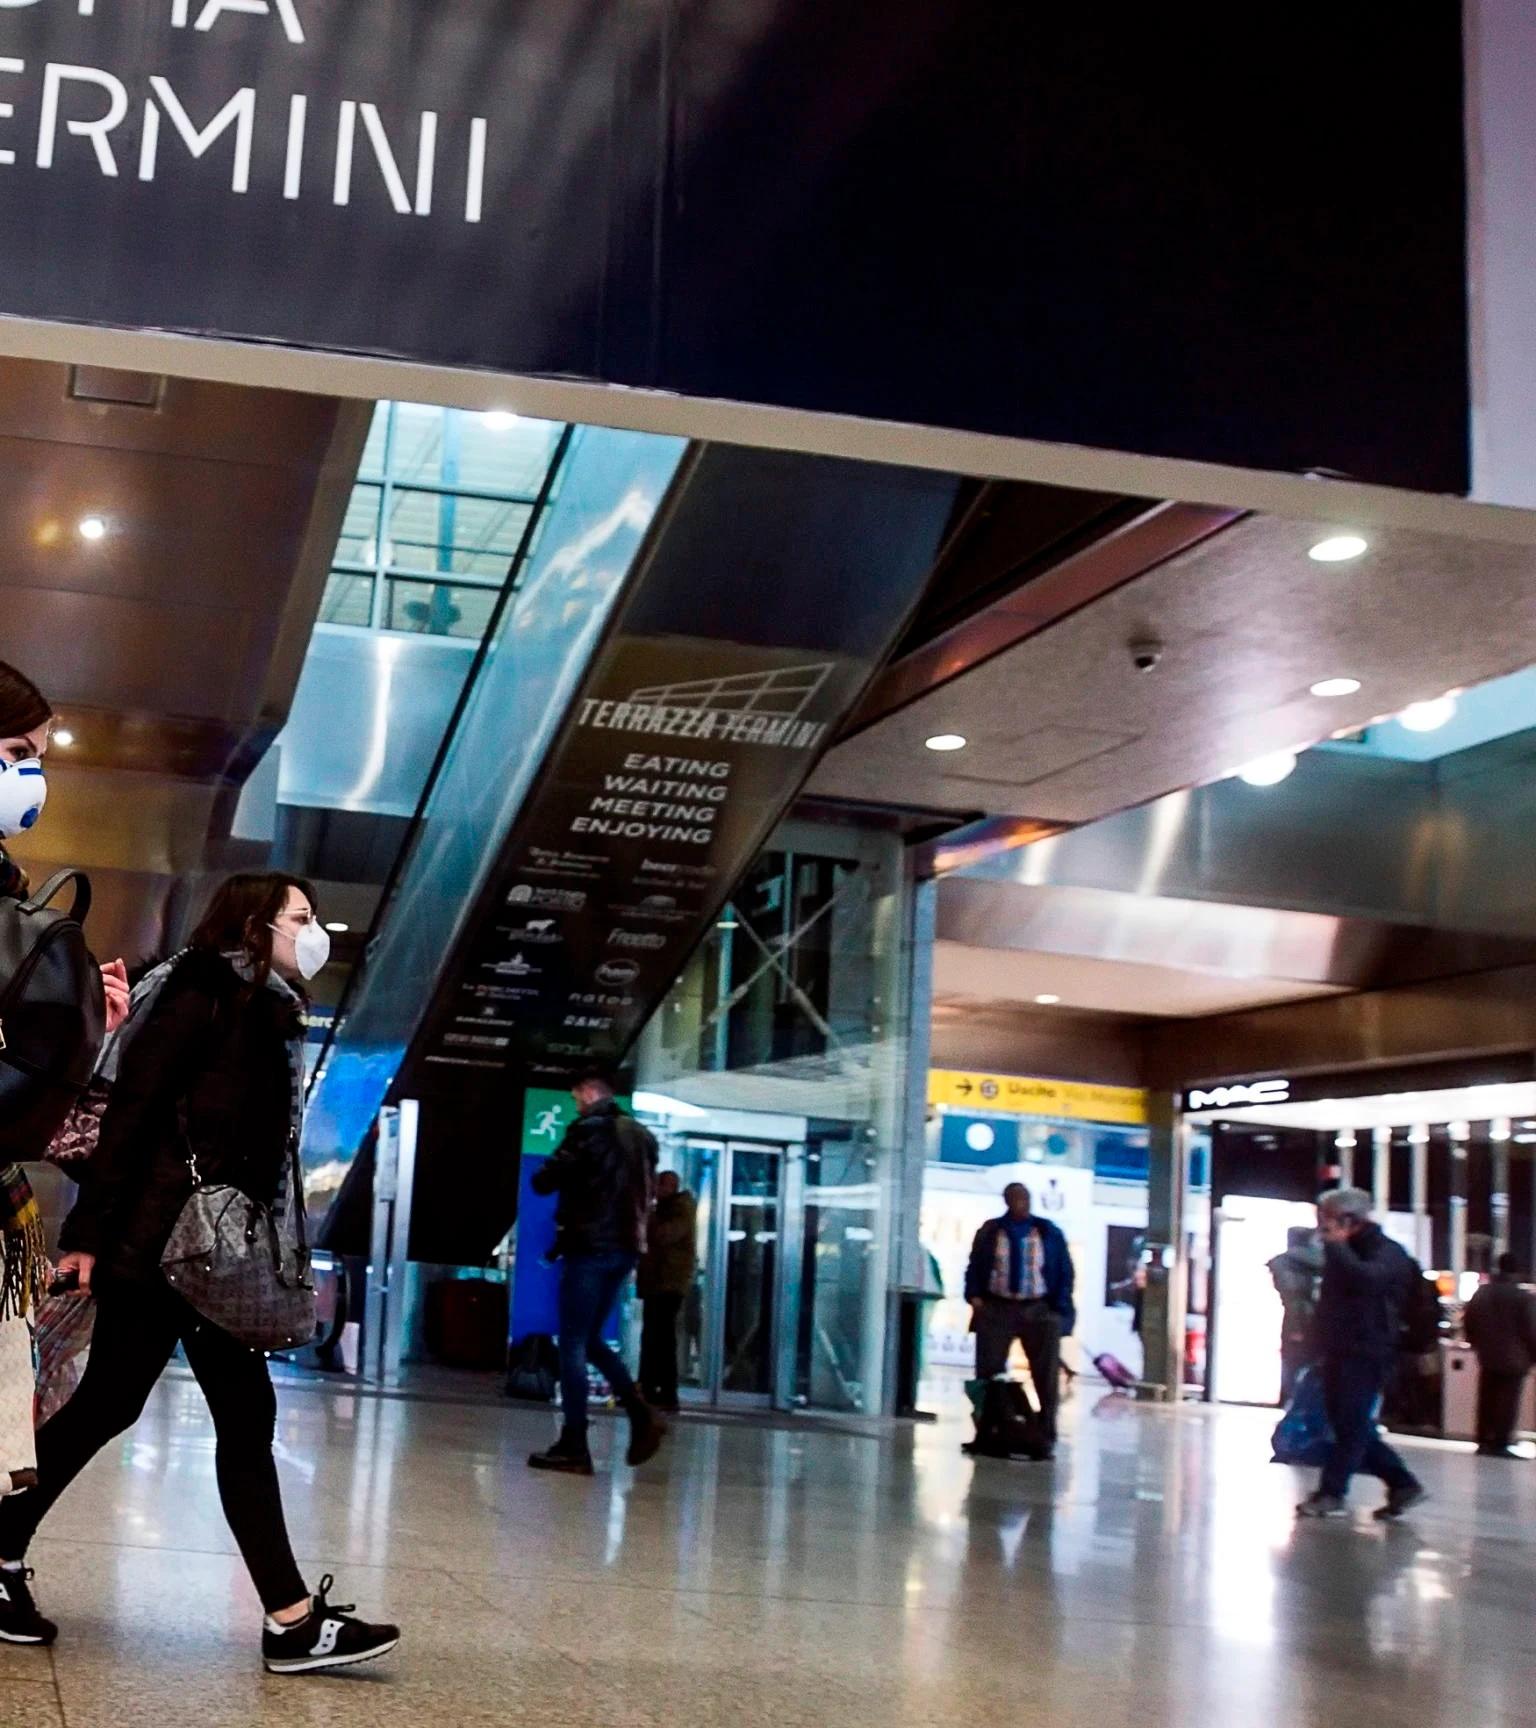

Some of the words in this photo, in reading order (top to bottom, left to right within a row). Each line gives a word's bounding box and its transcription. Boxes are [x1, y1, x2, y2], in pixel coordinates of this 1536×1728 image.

[579, 699, 718, 740] TERRAZZA
[719, 713, 829, 749] TERMINI
[623, 752, 731, 779] EATING
[603, 774, 728, 801] WAITING
[589, 796, 717, 823] MEETING
[570, 816, 713, 845] ENJOYING
